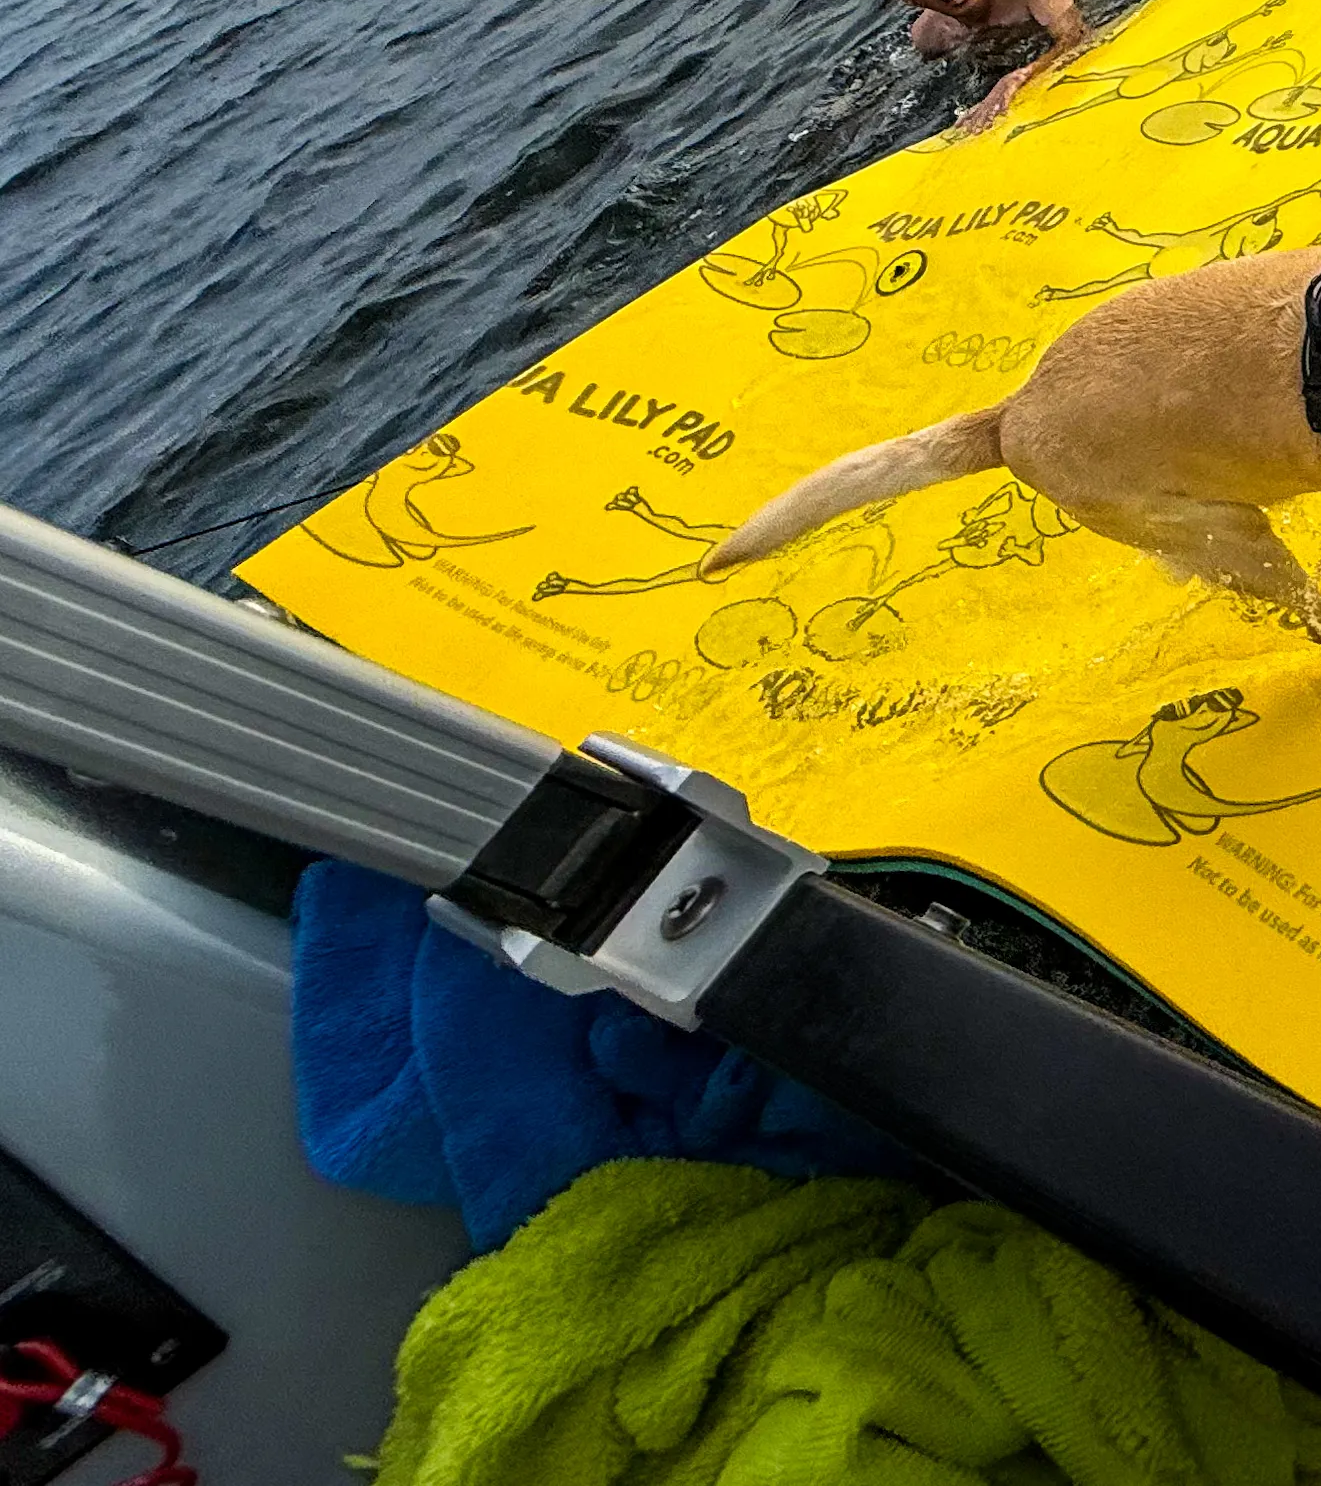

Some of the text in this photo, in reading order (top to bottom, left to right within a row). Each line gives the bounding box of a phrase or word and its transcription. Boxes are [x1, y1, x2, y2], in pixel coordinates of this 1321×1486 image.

[867, 201, 1070, 242] AQUA LILY PAD
[568, 382, 677, 429] LILY
[662, 410, 736, 460] PAD
[646, 445, 695, 476] .com
[1186, 855, 1222, 885] Not
[1218, 877, 1238, 898] to
[1236, 888, 1261, 914] be
[1259, 907, 1304, 941] used
[1298, 935, 1320, 955] as
